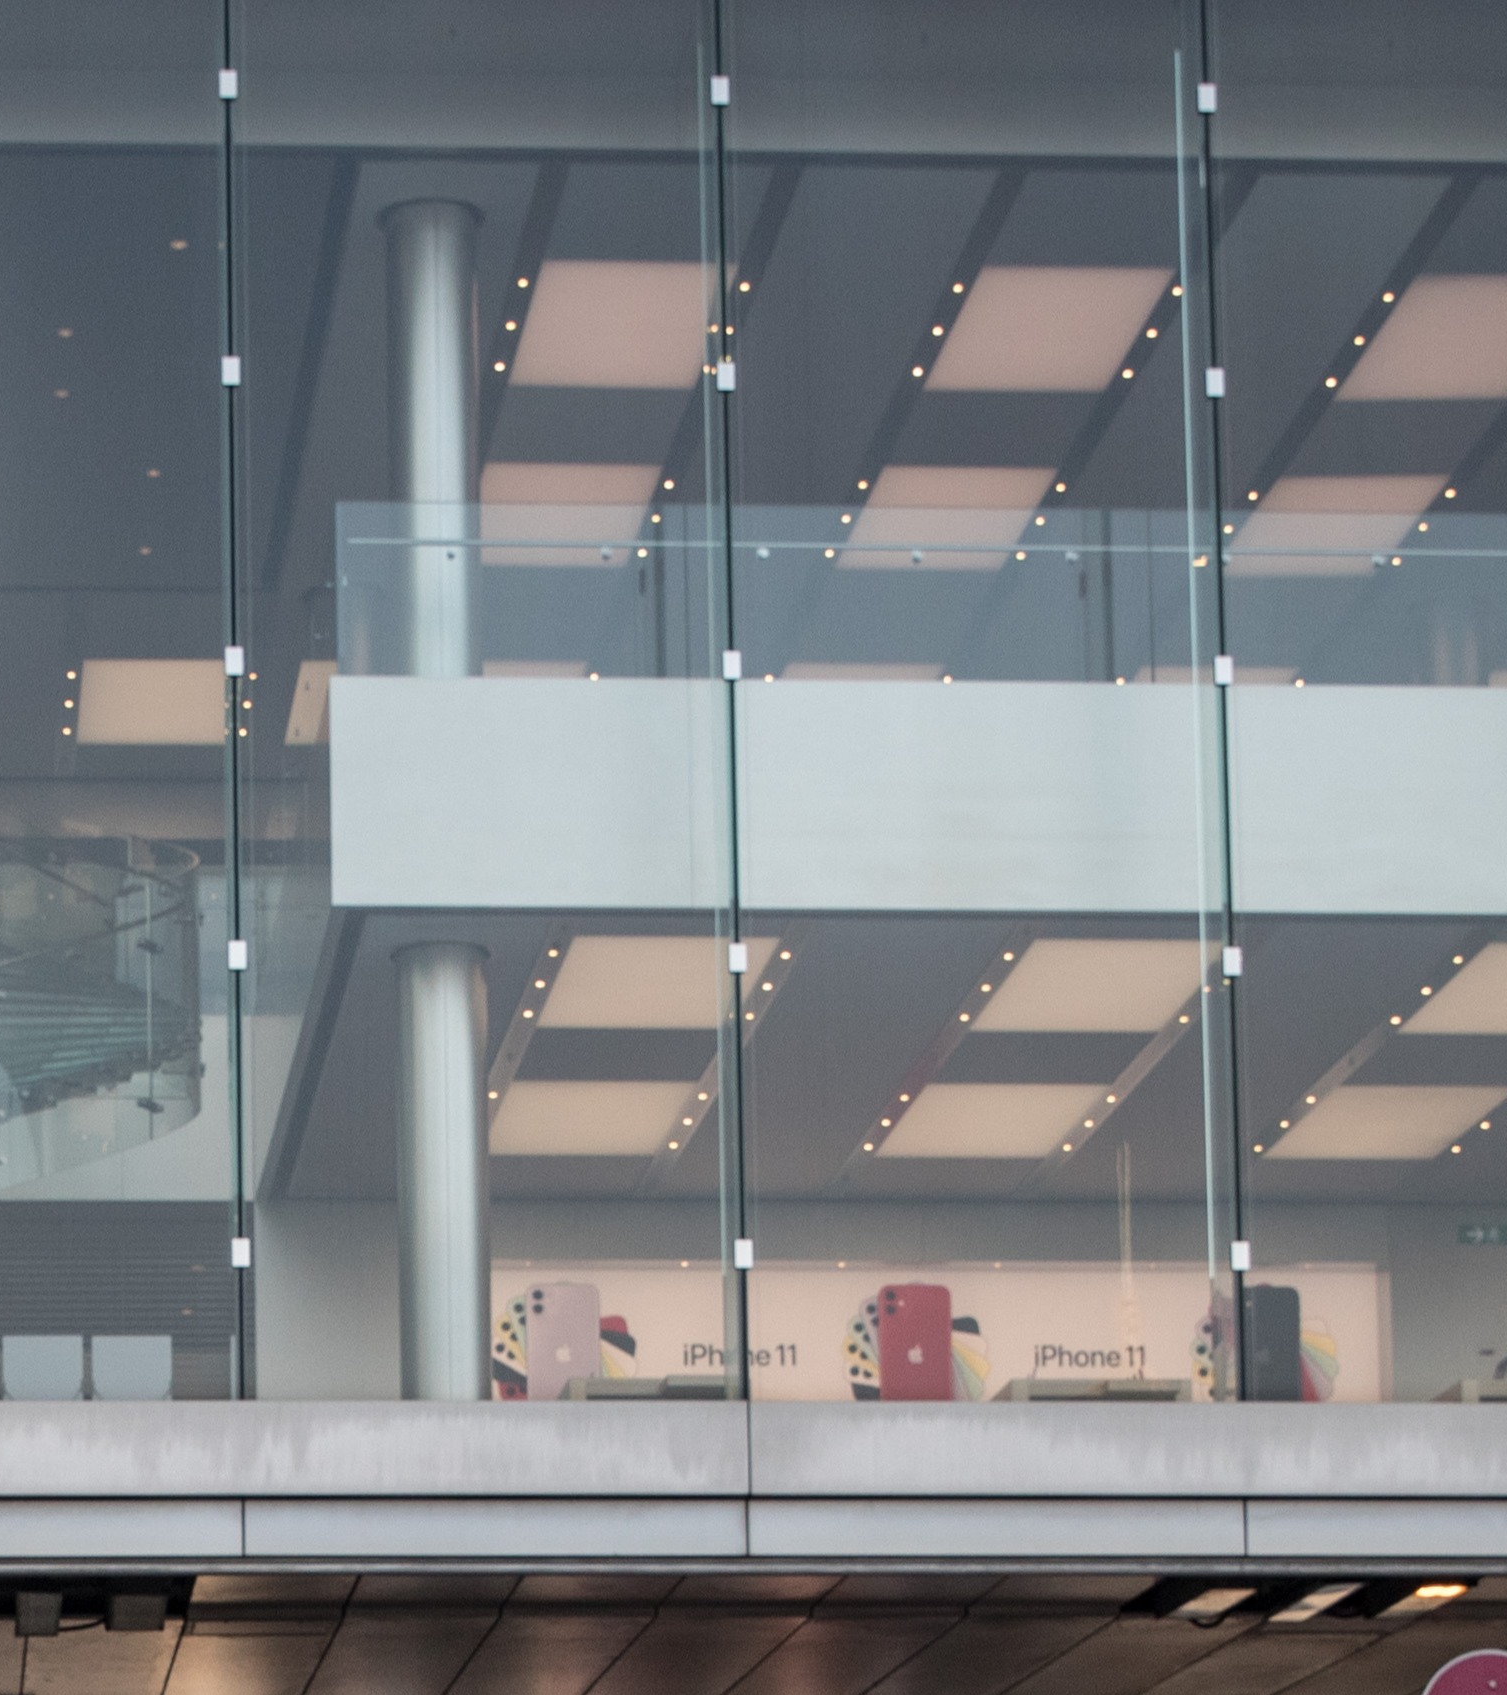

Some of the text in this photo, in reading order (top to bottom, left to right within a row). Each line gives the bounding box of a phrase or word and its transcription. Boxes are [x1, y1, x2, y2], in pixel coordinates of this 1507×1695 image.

[683, 1343, 797, 1366] iPhne 11
[1034, 1344, 1146, 1368] iPhone 11
